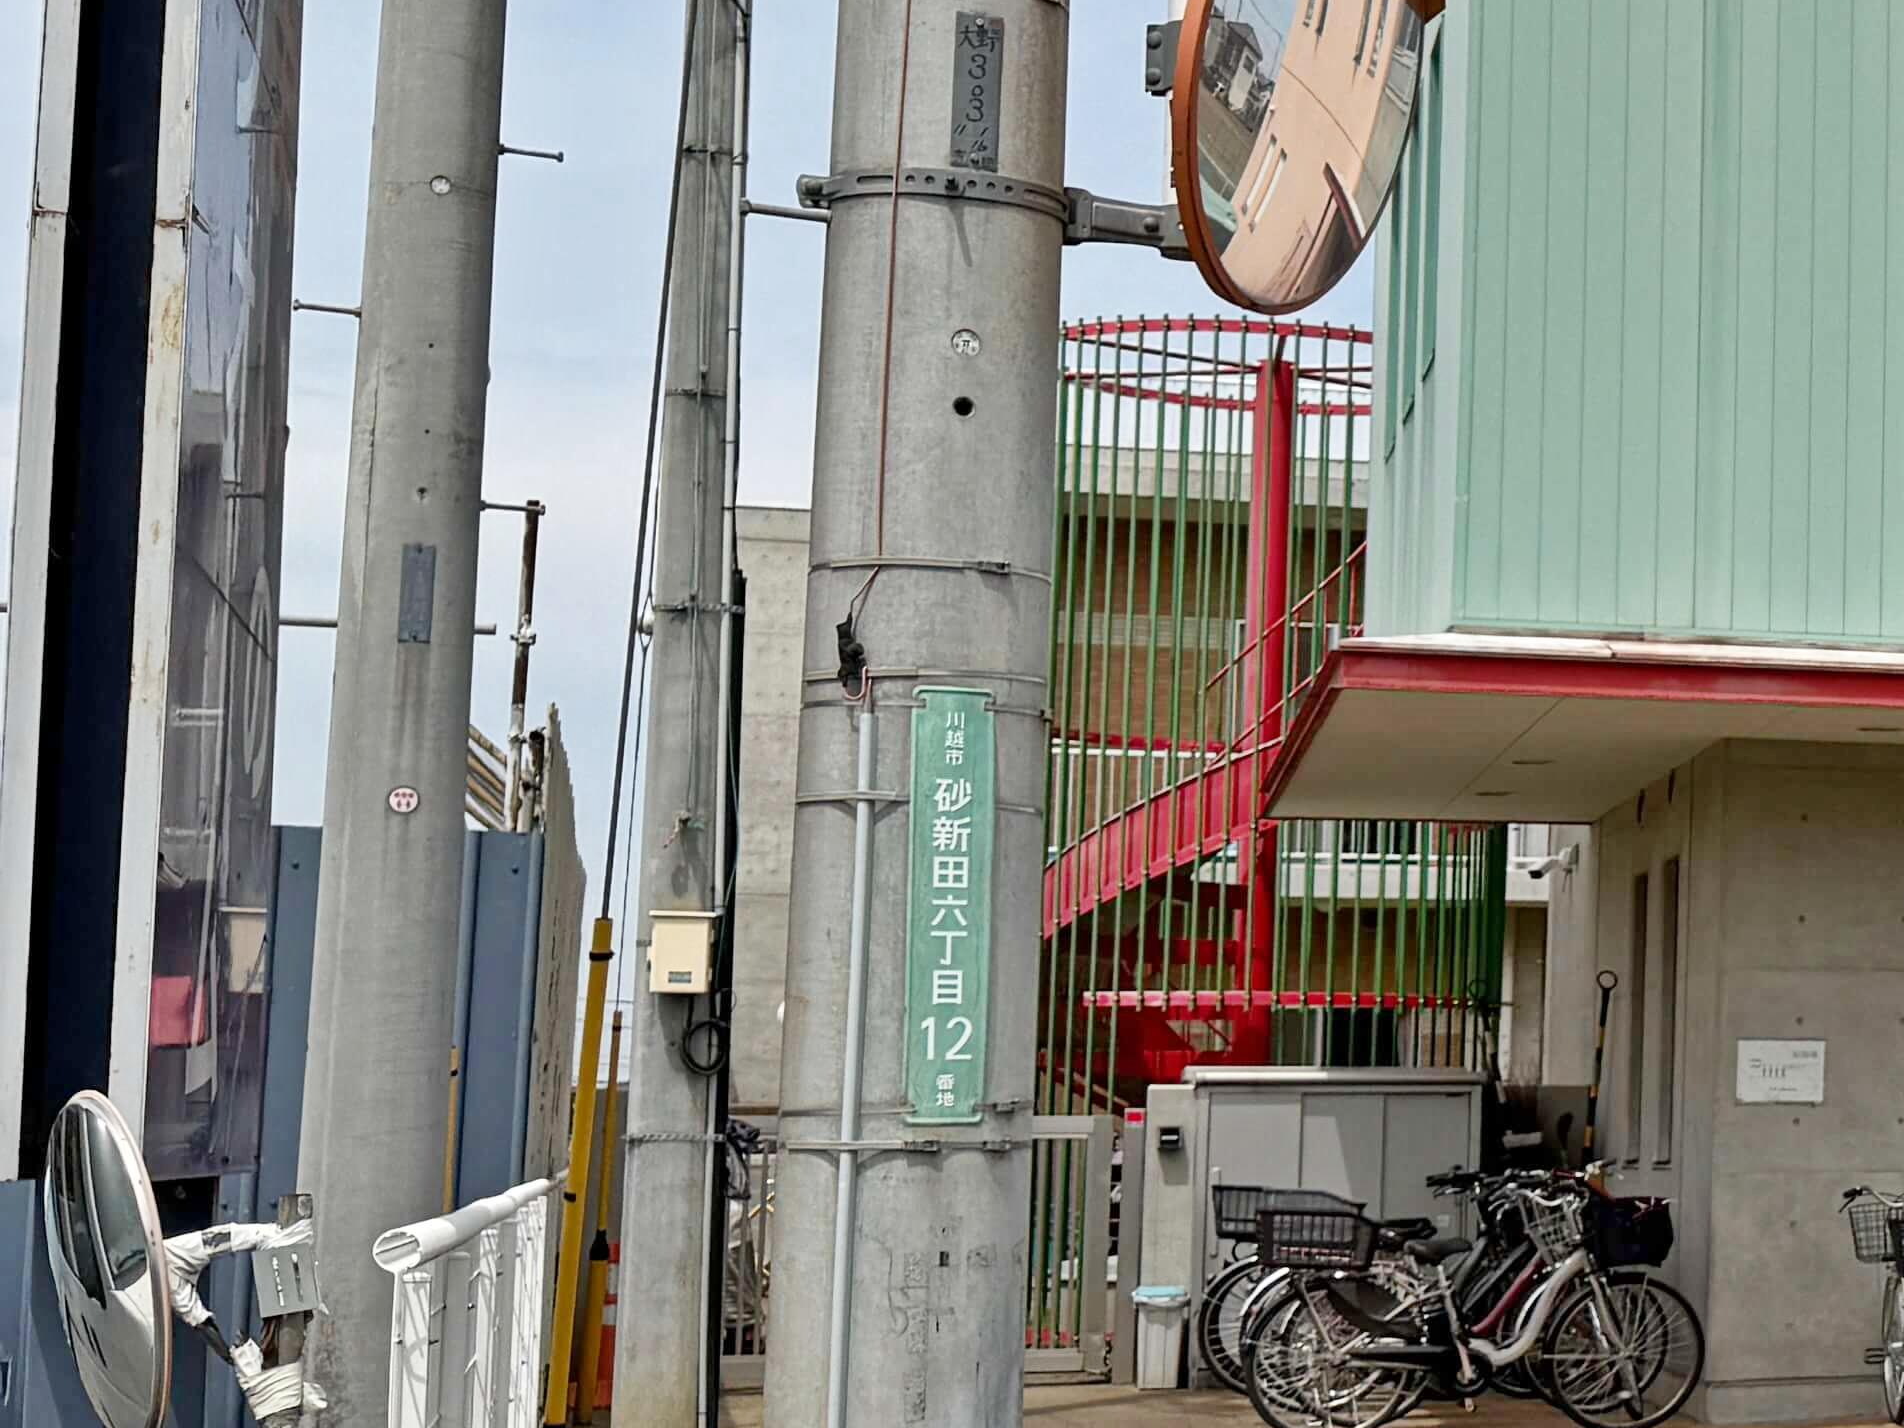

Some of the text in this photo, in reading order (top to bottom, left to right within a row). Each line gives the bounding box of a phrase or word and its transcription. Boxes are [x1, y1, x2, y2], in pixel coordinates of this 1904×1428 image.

[920, 711, 973, 1107] 川越市 砂新田六丁目 12 番地
